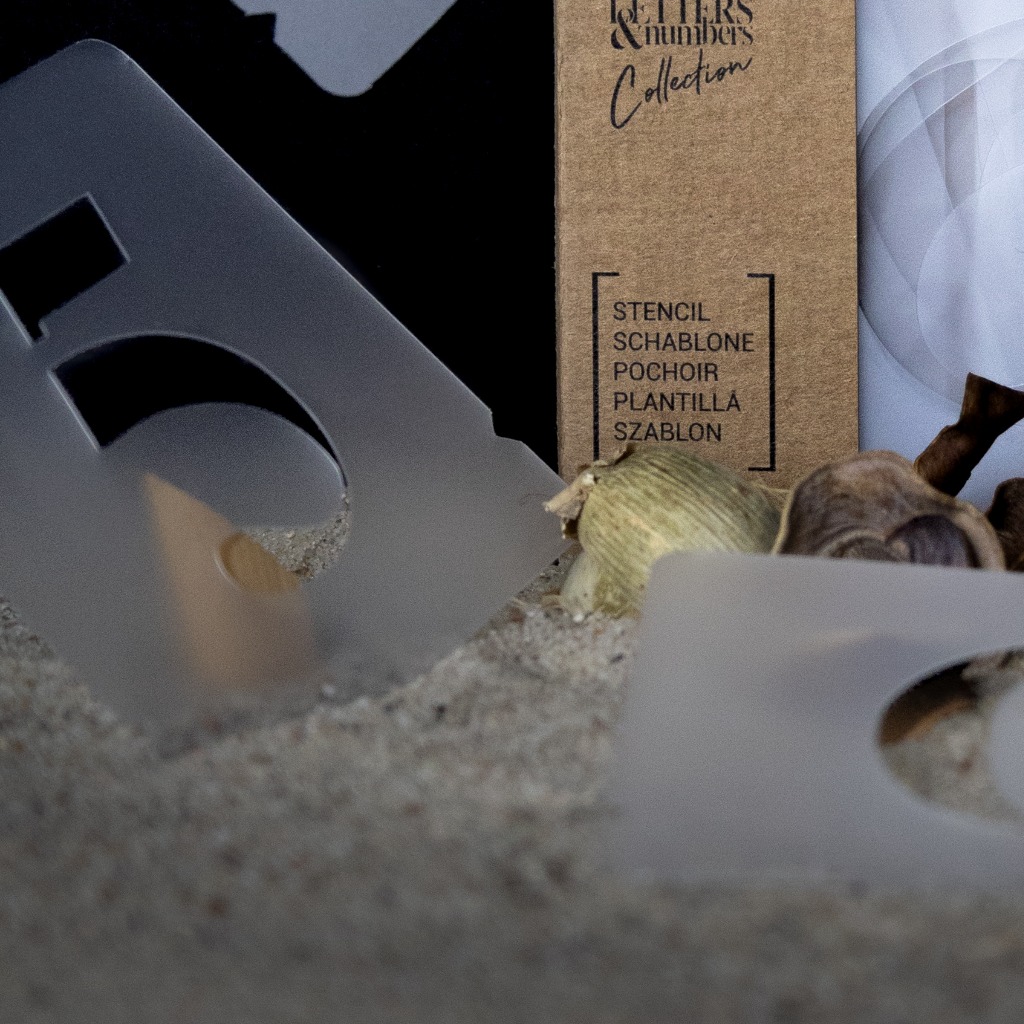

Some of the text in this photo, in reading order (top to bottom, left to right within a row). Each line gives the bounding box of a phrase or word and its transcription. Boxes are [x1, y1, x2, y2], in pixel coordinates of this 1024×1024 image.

[644, 20, 754, 46] numbers
[610, 48, 753, 129] Collection
[613, 301, 711, 322] STENCIL
[613, 332, 755, 352] SCHABLONE
[613, 362, 719, 382] POCHOIR
[613, 423, 722, 442] SZABLON
